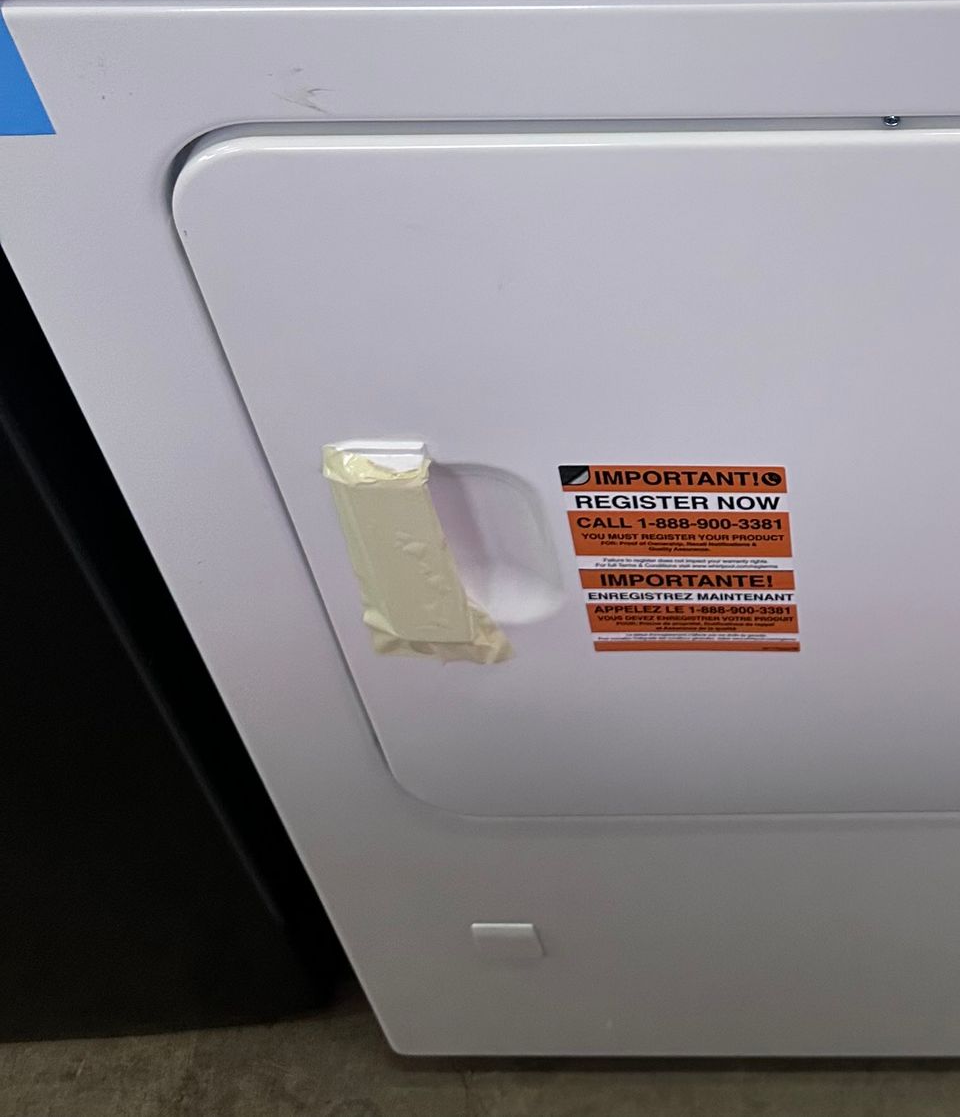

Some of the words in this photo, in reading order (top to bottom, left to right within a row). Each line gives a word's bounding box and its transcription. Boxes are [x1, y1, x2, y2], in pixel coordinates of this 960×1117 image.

[594, 470, 760, 486] IMPORTANT!
[575, 495, 709, 510] REGISTER
[717, 496, 780, 510] NOW
[576, 517, 633, 529] CALL
[637, 518, 782, 530] 1-888-900-3381
[600, 574, 773, 588] IMPORTANTE!
[588, 592, 693, 600] ENREGISTREZ
[697, 593, 794, 601] MAINTENANT
[594, 605, 662, 614] APPELEZ
[665, 606, 685, 614] LE
[689, 606, 791, 614] 1-888-900-3381
